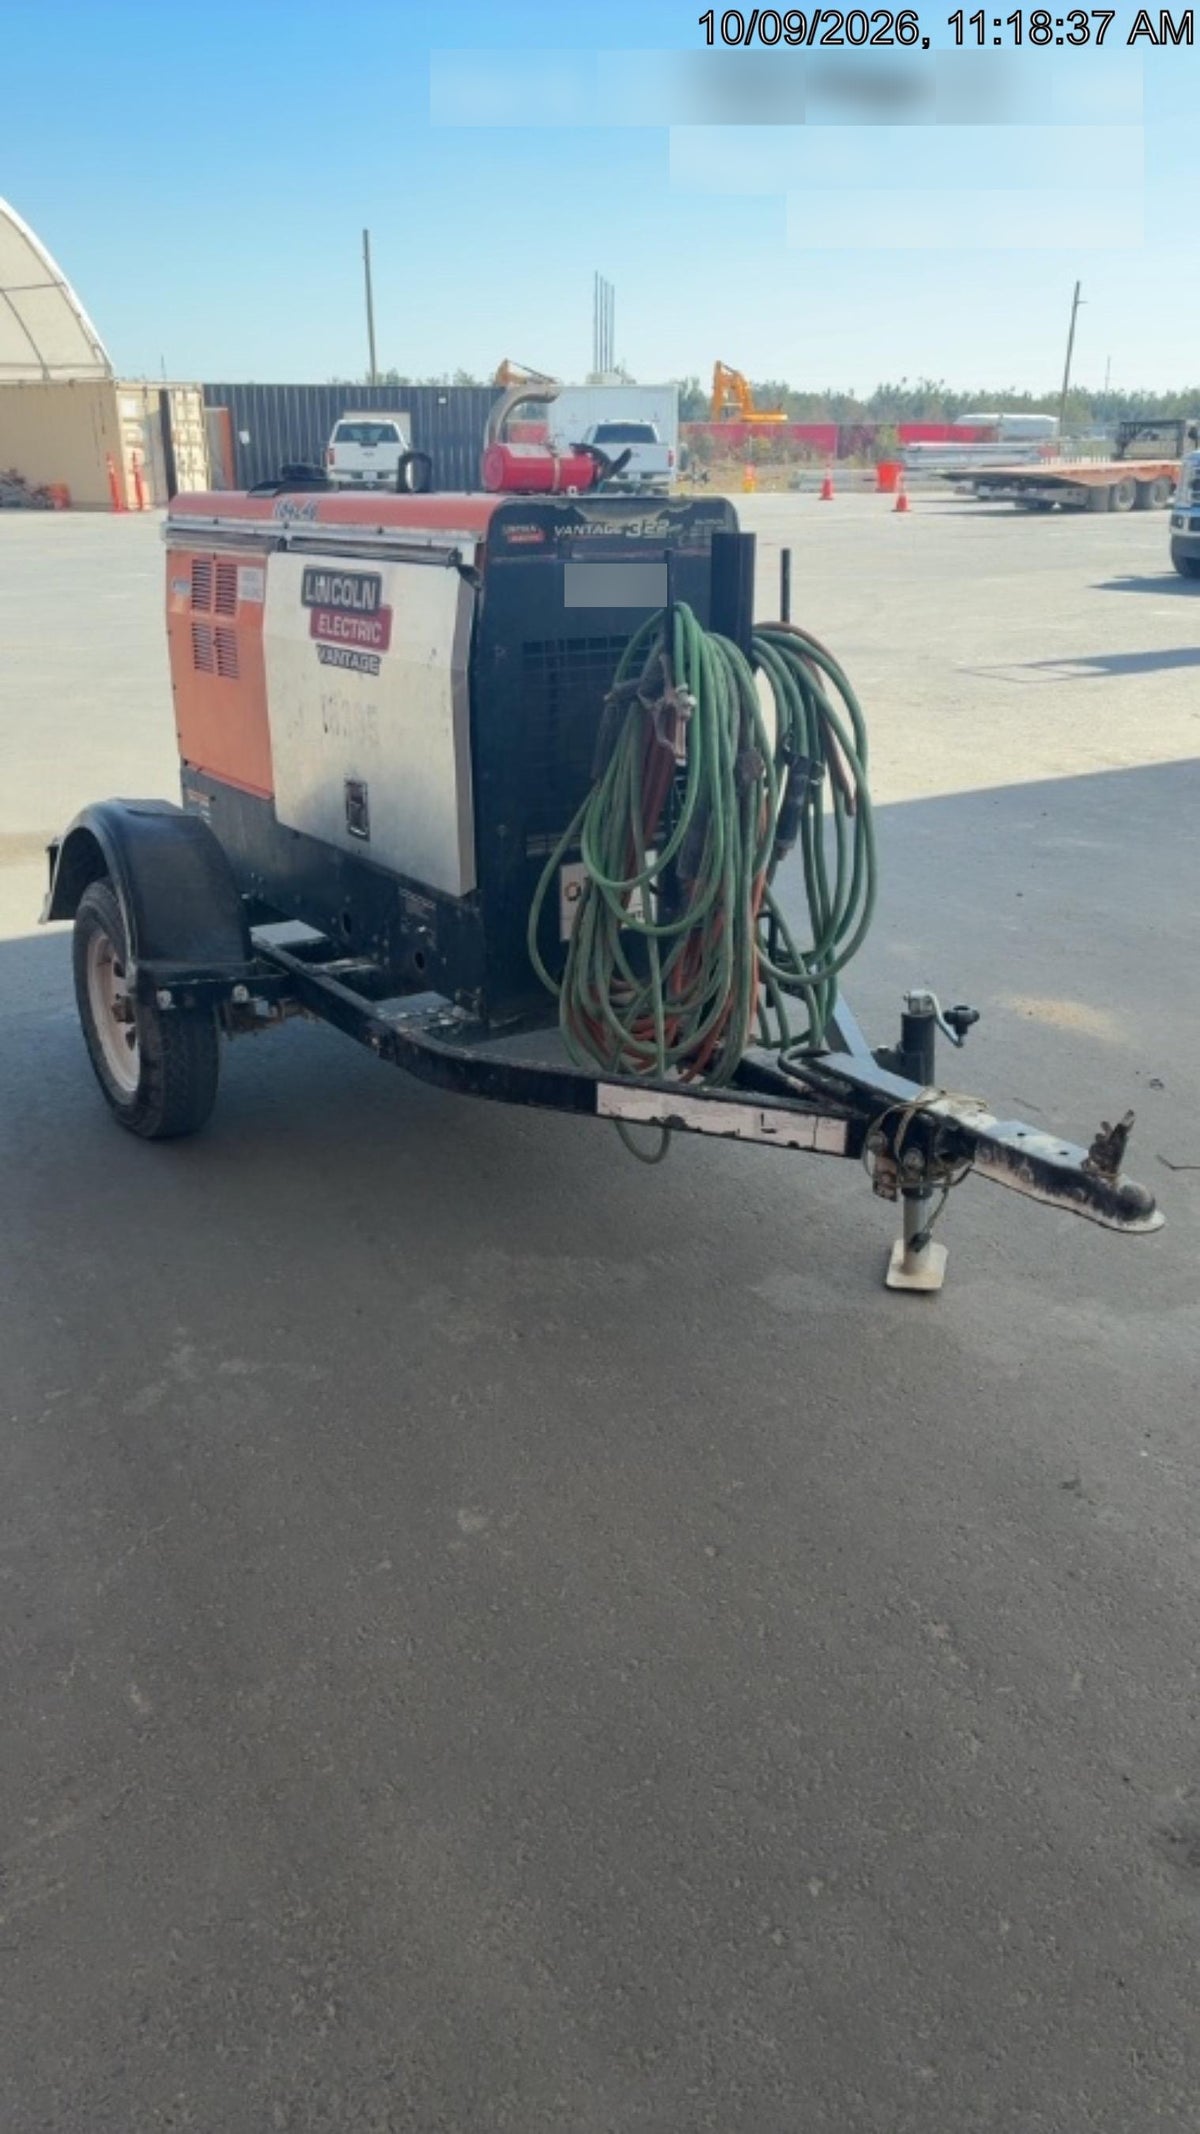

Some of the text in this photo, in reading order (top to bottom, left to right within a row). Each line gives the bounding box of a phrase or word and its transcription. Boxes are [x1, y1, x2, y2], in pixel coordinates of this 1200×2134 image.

[305, 573, 376, 610] LINCOLN
[317, 613, 383, 643] ELECTRIC
[318, 647, 380, 673] VANTAGE
